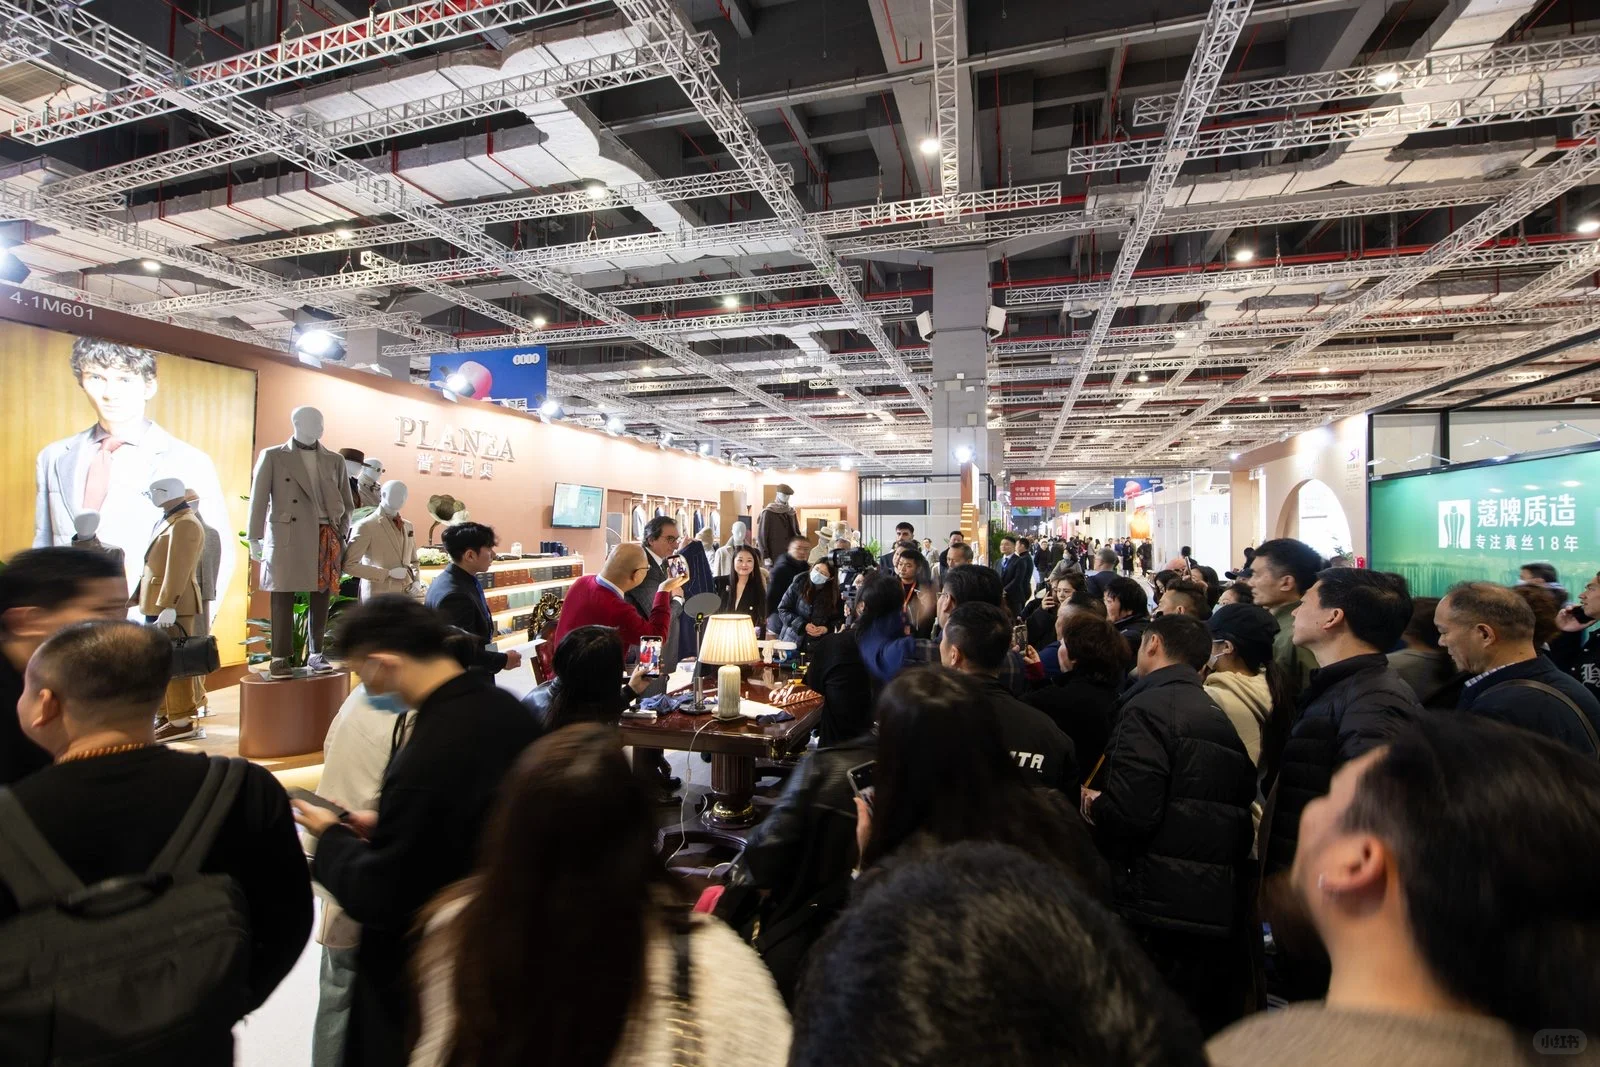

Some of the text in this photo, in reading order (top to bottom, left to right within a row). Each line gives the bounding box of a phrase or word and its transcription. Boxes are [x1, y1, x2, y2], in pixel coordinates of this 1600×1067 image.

[9, 291, 94, 321] 4.1M601
[394, 416, 515, 462] PLANEA
[417, 453, 494, 480] 普兰尼奥
[1477, 493, 1576, 528] 蔻牌质造
[1475, 533, 1579, 552] 专注真丝18年
